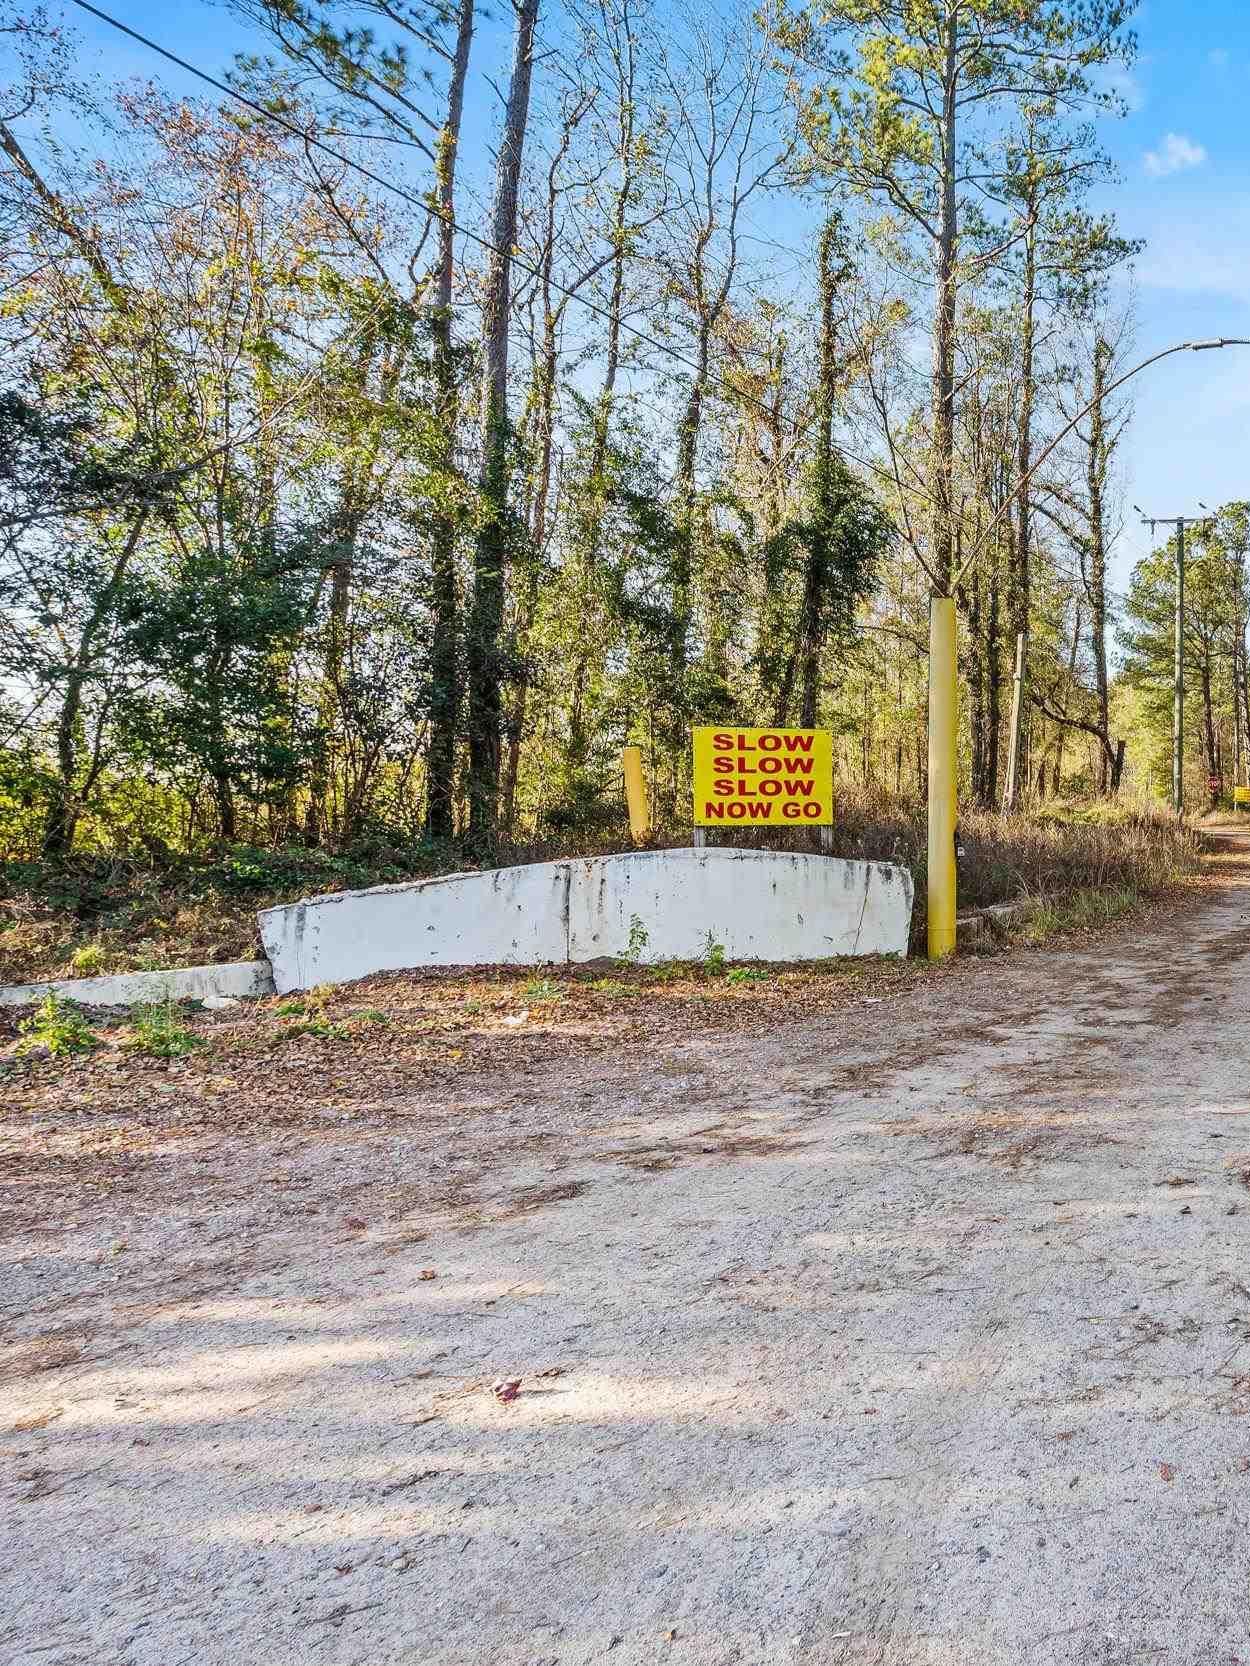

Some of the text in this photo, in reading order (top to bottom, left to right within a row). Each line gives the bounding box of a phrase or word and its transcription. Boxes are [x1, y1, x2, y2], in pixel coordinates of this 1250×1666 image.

[713, 733, 815, 752] SLOW
[713, 756, 815, 774] SLOW
[713, 779, 815, 796] SLOW
[705, 801, 822, 819] NOW GO
